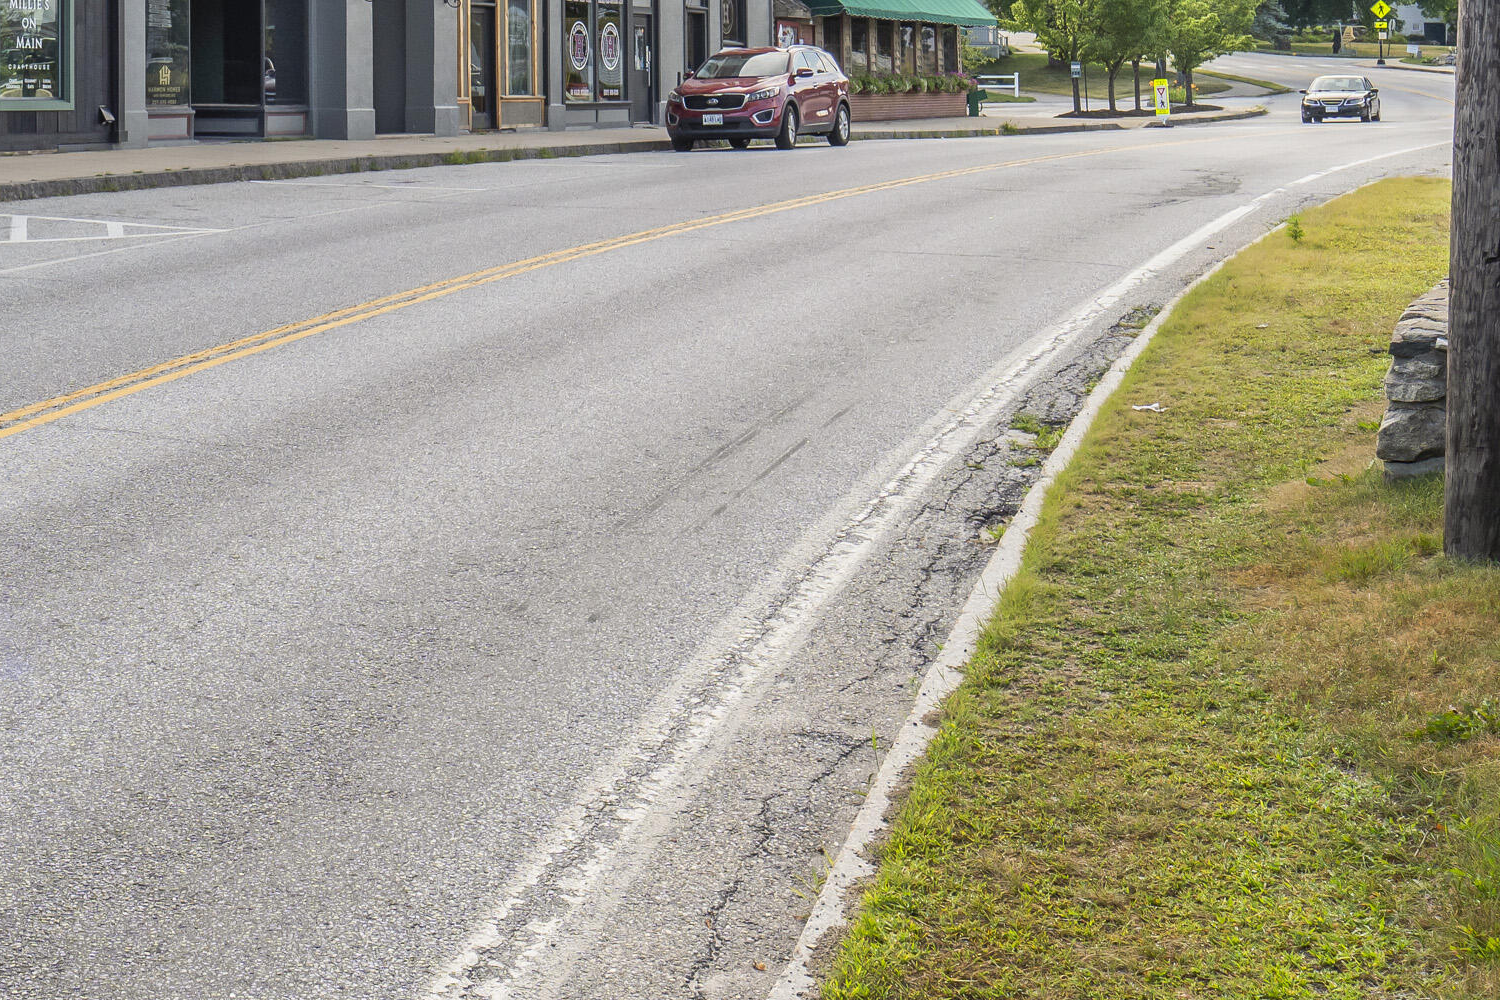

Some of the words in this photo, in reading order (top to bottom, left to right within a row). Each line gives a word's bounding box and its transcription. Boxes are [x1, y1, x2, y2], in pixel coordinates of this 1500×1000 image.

[21, 17, 36, 29] ON
[16, 35, 43, 49] MAIN
[8, 63, 50, 71] CRAFTHOUSE
